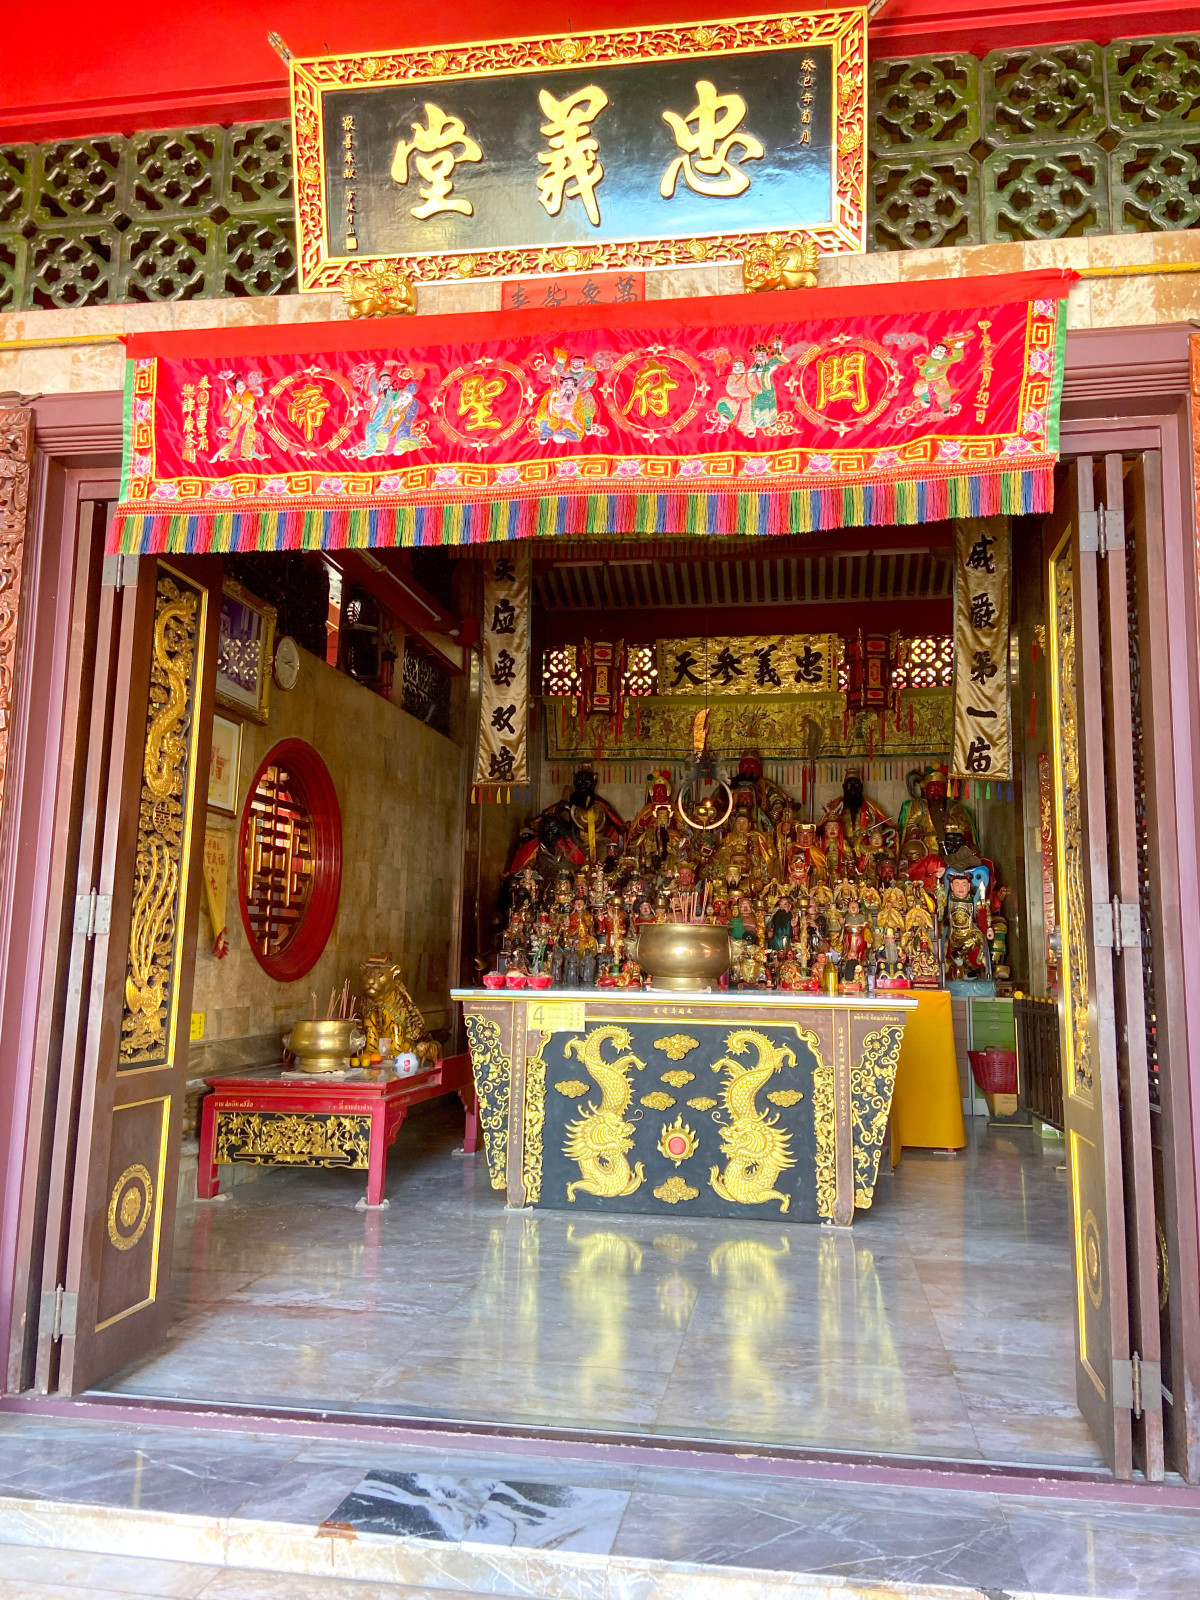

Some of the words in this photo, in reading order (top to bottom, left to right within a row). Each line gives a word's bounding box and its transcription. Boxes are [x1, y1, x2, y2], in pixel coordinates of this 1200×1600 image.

[390, 80, 765, 227] 忠義堂
[288, 384, 331, 442] 帝
[457, 374, 508, 432] 聖
[532, 1005, 545, 1025] 4
